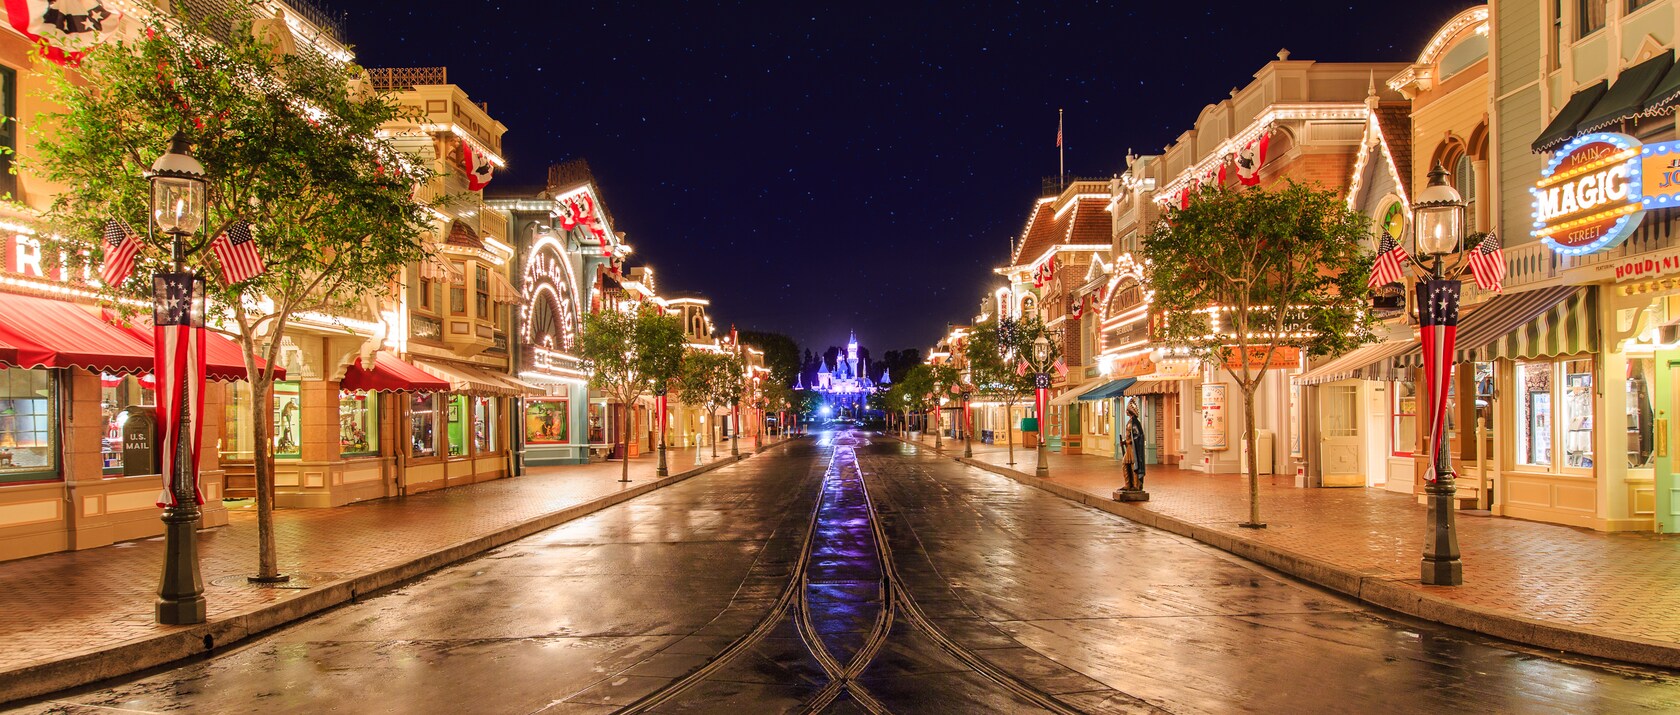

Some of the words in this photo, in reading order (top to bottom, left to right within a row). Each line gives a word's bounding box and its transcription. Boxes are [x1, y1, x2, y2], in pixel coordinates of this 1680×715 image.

[1571, 147, 1601, 165] MAIN
[1537, 165, 1627, 222] MAGIC
[1567, 225, 1602, 244] STREET
[126, 442, 149, 450] MAIL
